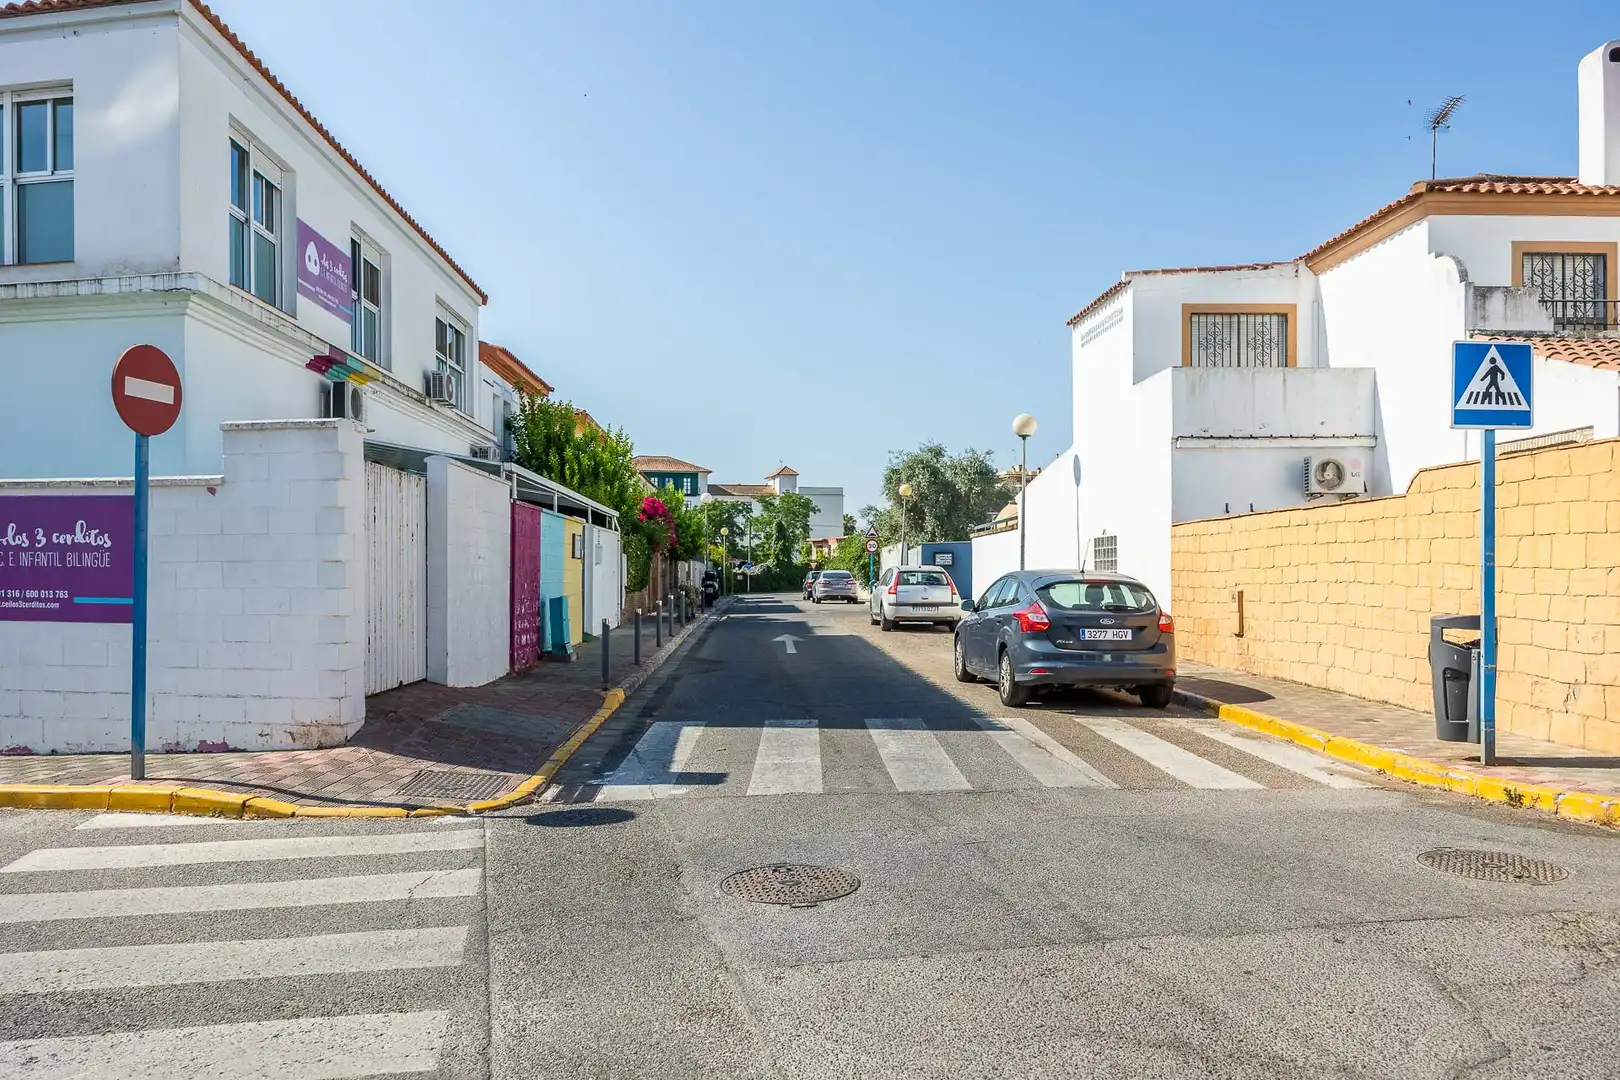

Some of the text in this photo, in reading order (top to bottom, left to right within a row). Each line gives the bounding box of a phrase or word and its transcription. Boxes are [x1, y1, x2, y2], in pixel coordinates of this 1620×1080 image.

[2, 520, 112, 547] los 3 cerditos
[19, 551, 62, 567] INFANTIL
[66, 549, 111, 568] BILINGÜE
[7, 590, 20, 598] 316
[25, 590, 39, 598] 600
[40, 590, 54, 598] 013
[55, 590, 69, 598] 763
[1087, 630, 1128, 639] 3277 HGV
